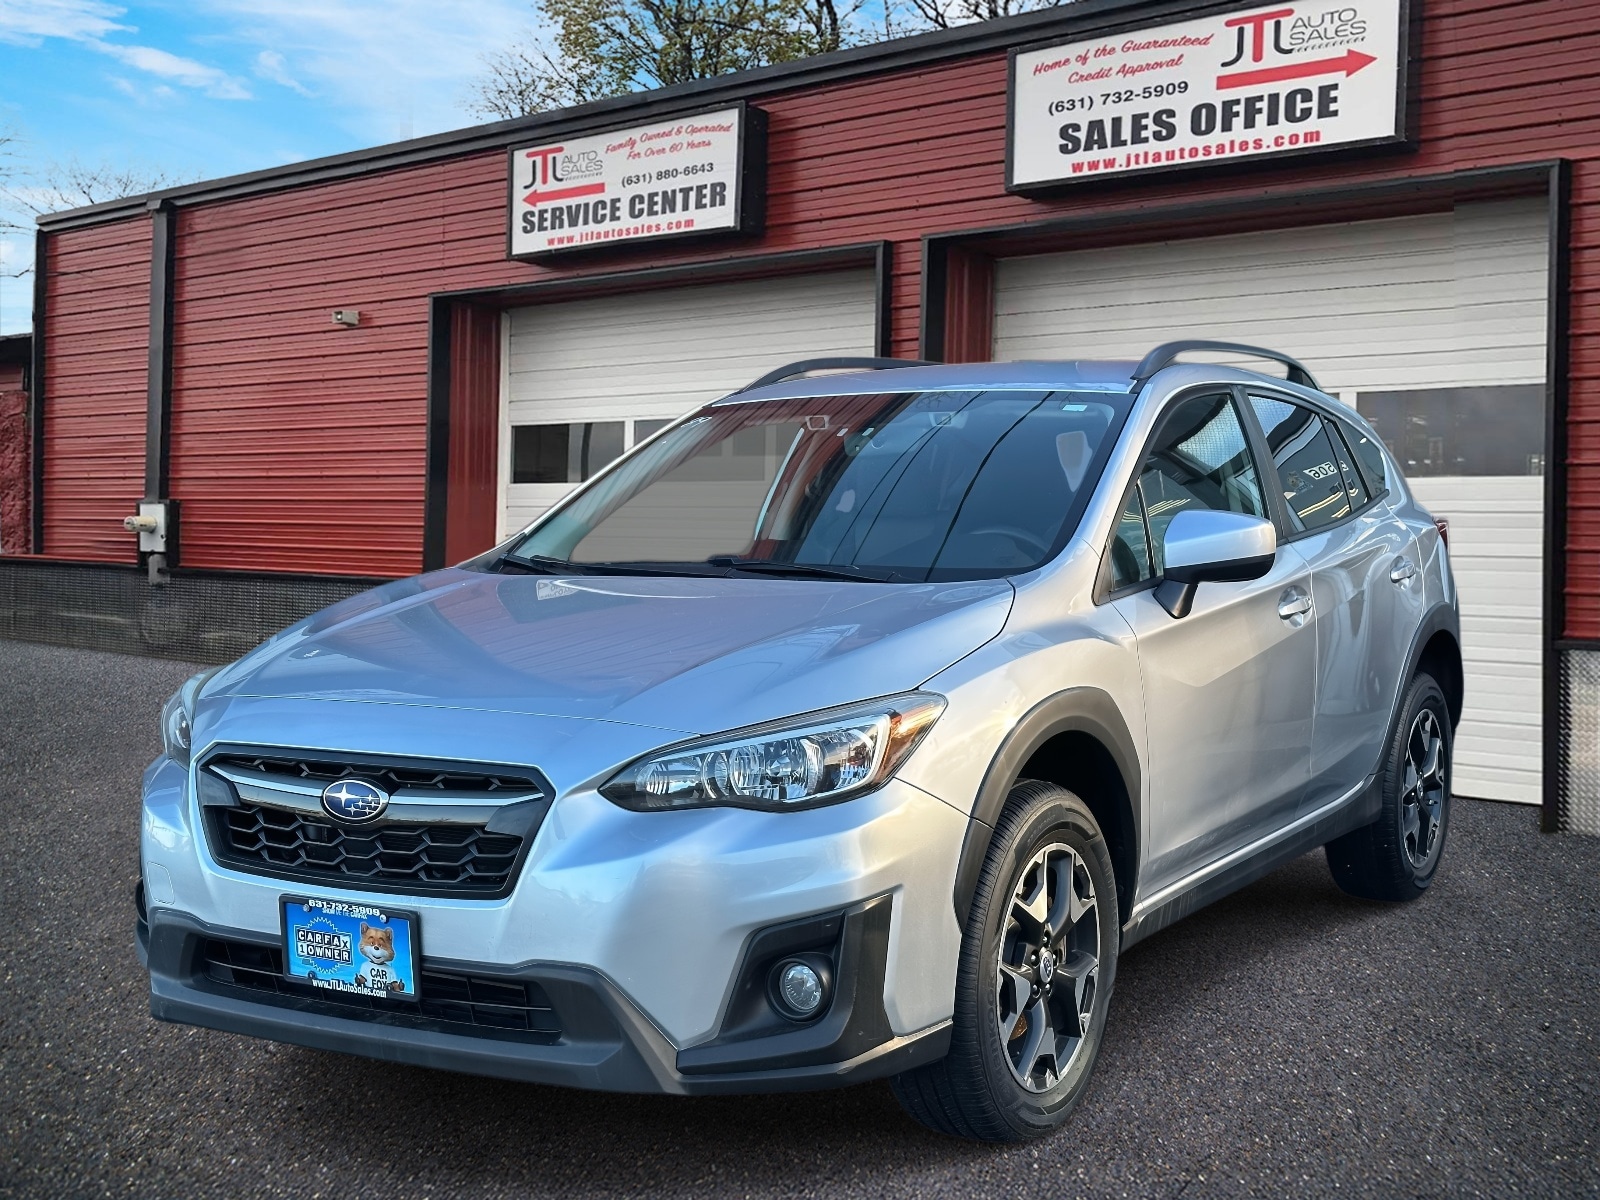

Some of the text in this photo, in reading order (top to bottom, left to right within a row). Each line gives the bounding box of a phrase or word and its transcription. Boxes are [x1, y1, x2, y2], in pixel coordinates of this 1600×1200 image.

[1290, 7, 1357, 32] AUTO
[1220, 8, 1295, 68] JTL
[1289, 20, 1367, 46] SALES
[1033, 33, 1215, 76] Home of the Guaranteed
[1068, 53, 1183, 85] Credit Approval
[1048, 81, 1189, 116] (631) 732-5909
[1059, 83, 1339, 155] SALES OFFICE
[605, 122, 734, 154] Family Owned & Operated
[627, 138, 712, 160] For Over 60 Years
[561, 150, 598, 165] AUTO
[1071, 129, 1321, 174] www.jtlautosales.com
[523, 146, 564, 190] JTL
[561, 160, 603, 176] SALES
[621, 163, 714, 188] (631) 880-6643
[522, 181, 727, 234] SERVICE CENTER
[547, 217, 695, 246] www.jtlautosales.com
[308, 900, 380, 916] 631-732-5909
[298, 930, 350, 949] CARFAX
[370, 968, 387, 979] CAR
[372, 979, 387, 989] FOX
[312, 979, 387, 998] www.JTLAutoSales.com
